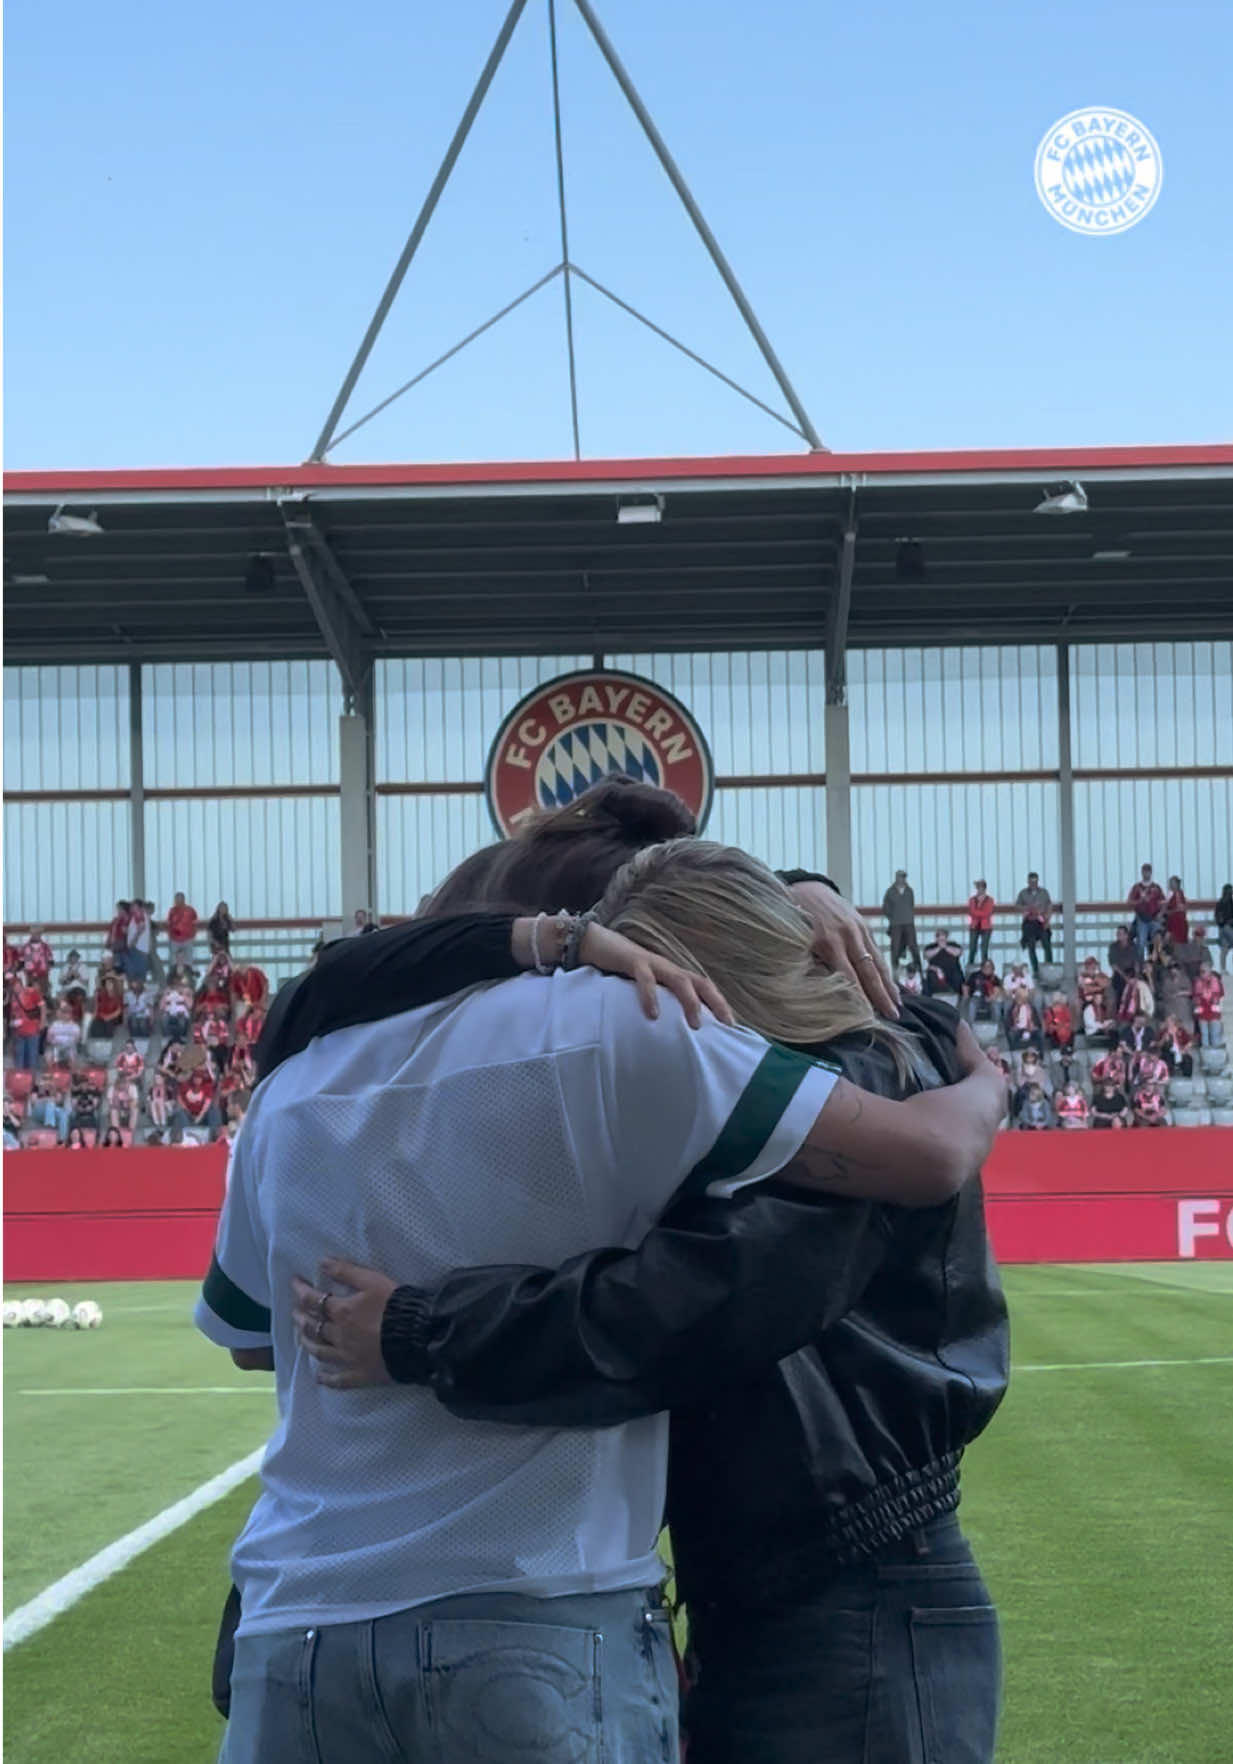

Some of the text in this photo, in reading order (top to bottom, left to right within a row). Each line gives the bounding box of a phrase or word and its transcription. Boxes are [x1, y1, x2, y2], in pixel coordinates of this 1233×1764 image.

[505, 686, 692, 769] FC BAYERN
[1178, 1199, 1233, 1257] F
